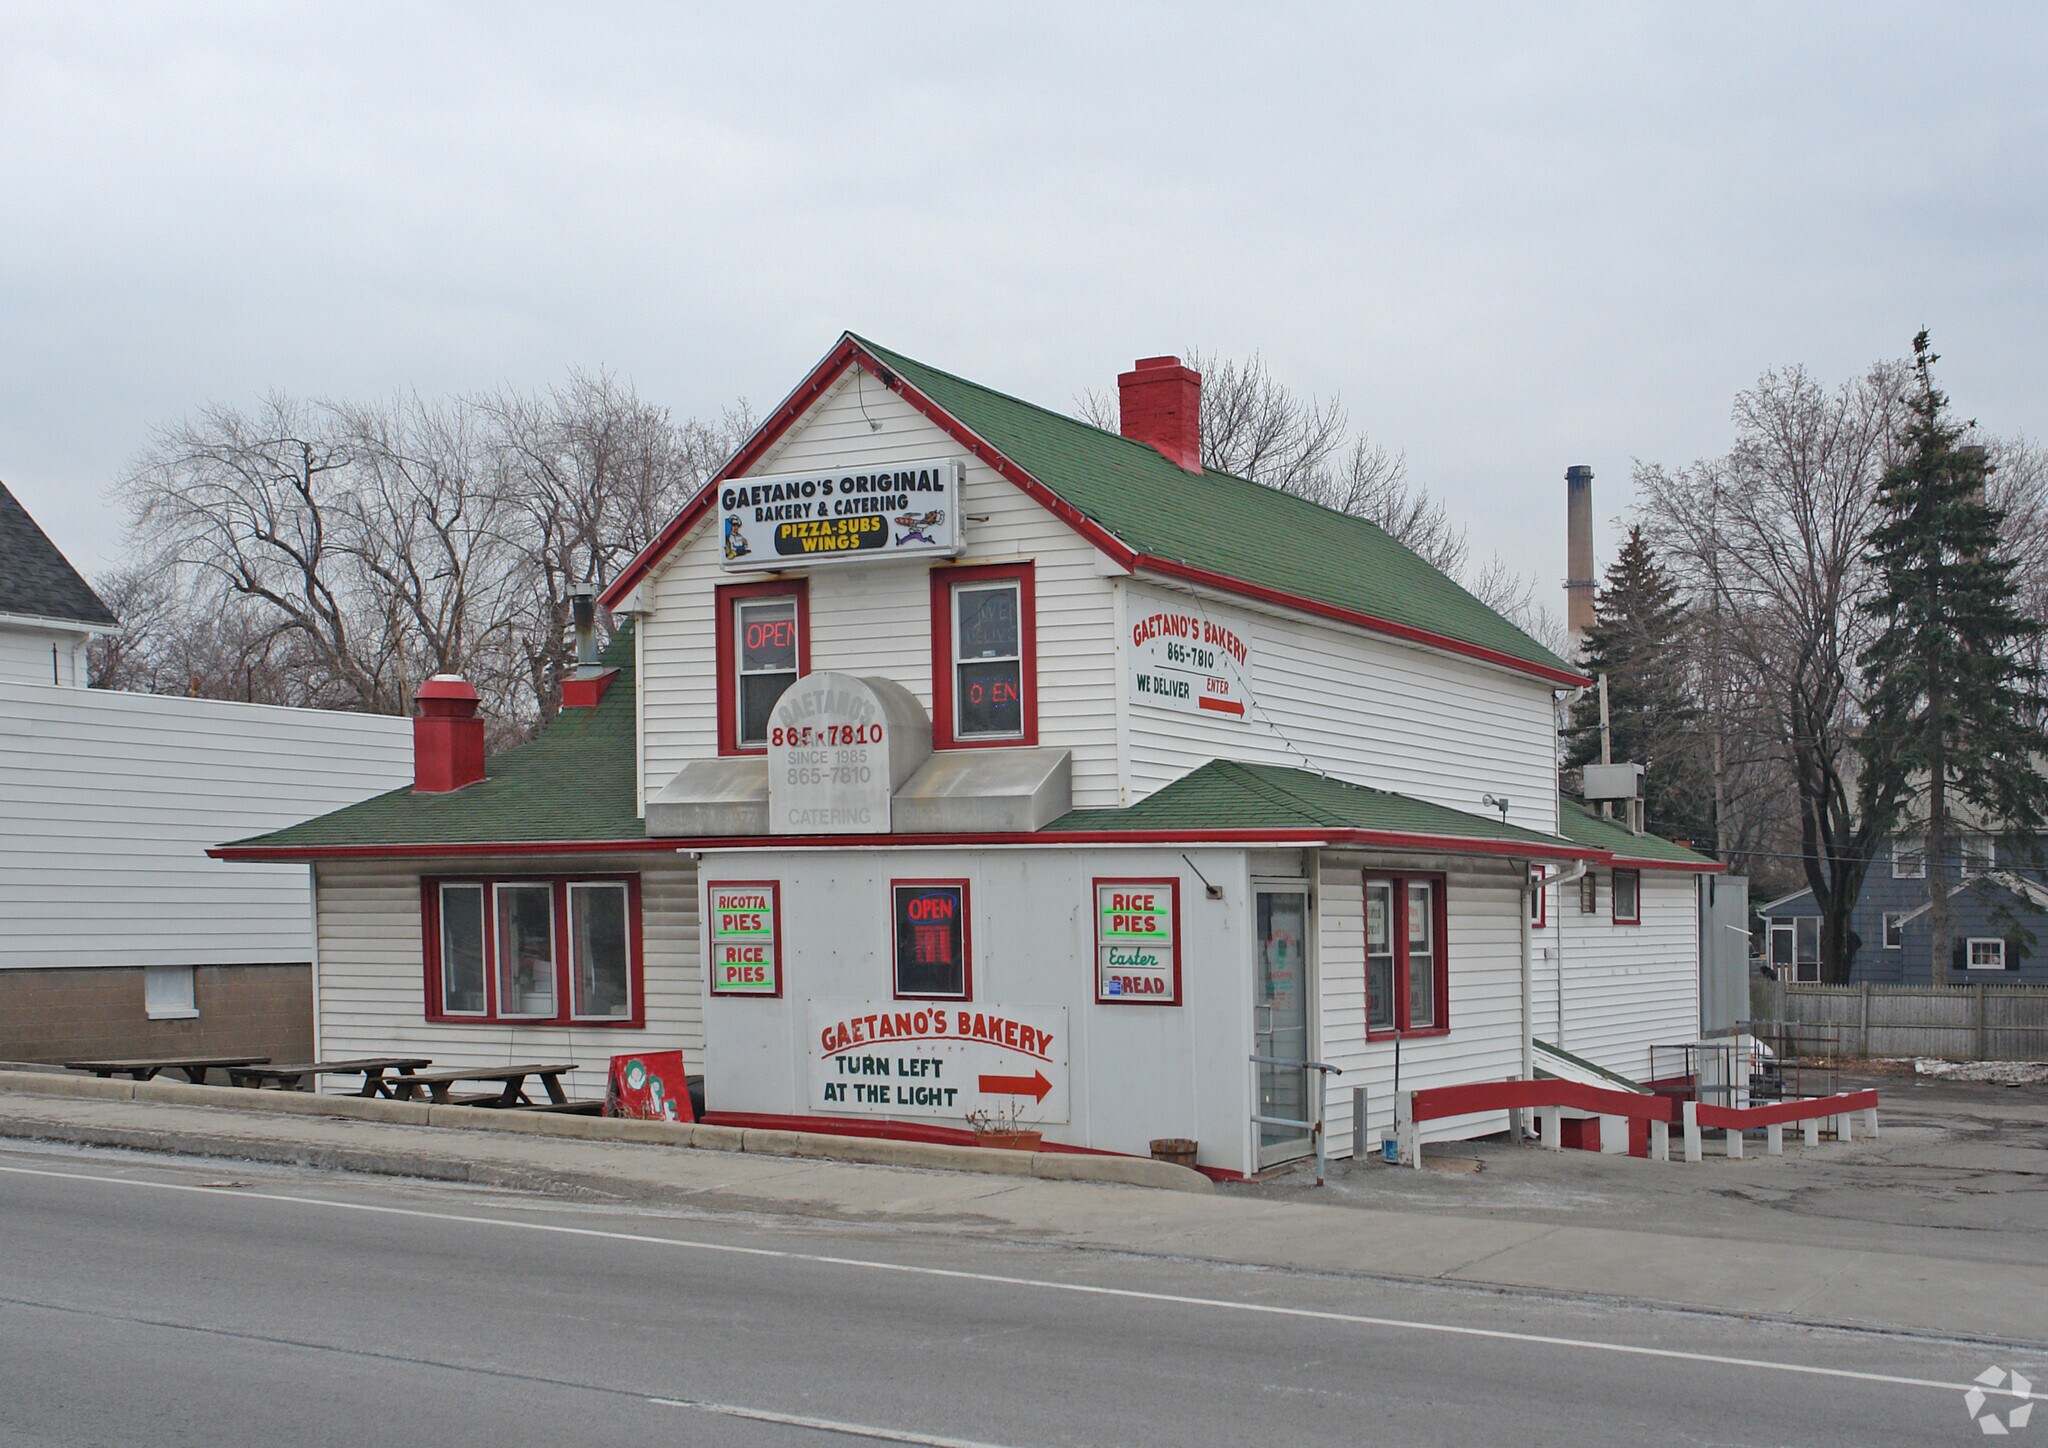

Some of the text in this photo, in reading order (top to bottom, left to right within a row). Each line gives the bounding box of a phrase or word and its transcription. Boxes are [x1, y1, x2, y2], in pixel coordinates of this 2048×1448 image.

[721, 468, 945, 511] GAETANO'S ORIGINAL
[755, 494, 909, 523] BAKERY & CATERING
[801, 534, 861, 552] WINGS
[1133, 613, 1247, 667] GAETANO'S BAKERY
[1167, 642, 1214, 668] 865-7810
[970, 682, 1017, 704] OEN
[1137, 673, 1190, 699] WE DELIVER
[1206, 678, 1229, 695] ENTER
[778, 689, 876, 728] GAETANO'S
[787, 749, 868, 765] SINCE 1985
[787, 765, 871, 785] 865-7810
[788, 807, 871, 826] CATERING
[718, 895, 767, 909] RICOTTA
[908, 898, 953, 920] OPEN
[1112, 893, 1155, 911] RICE
[722, 913, 762, 931] PIES
[1113, 915, 1156, 932] PIES
[725, 947, 764, 963] RICE
[1109, 946, 1159, 966] Easter
[726, 966, 766, 983] PIES
[821, 1007, 1054, 1056] GAETANO'S BAKERY
[835, 1055, 943, 1078] TURN LEFT
[824, 1082, 958, 1107] AT THE LIGHT
